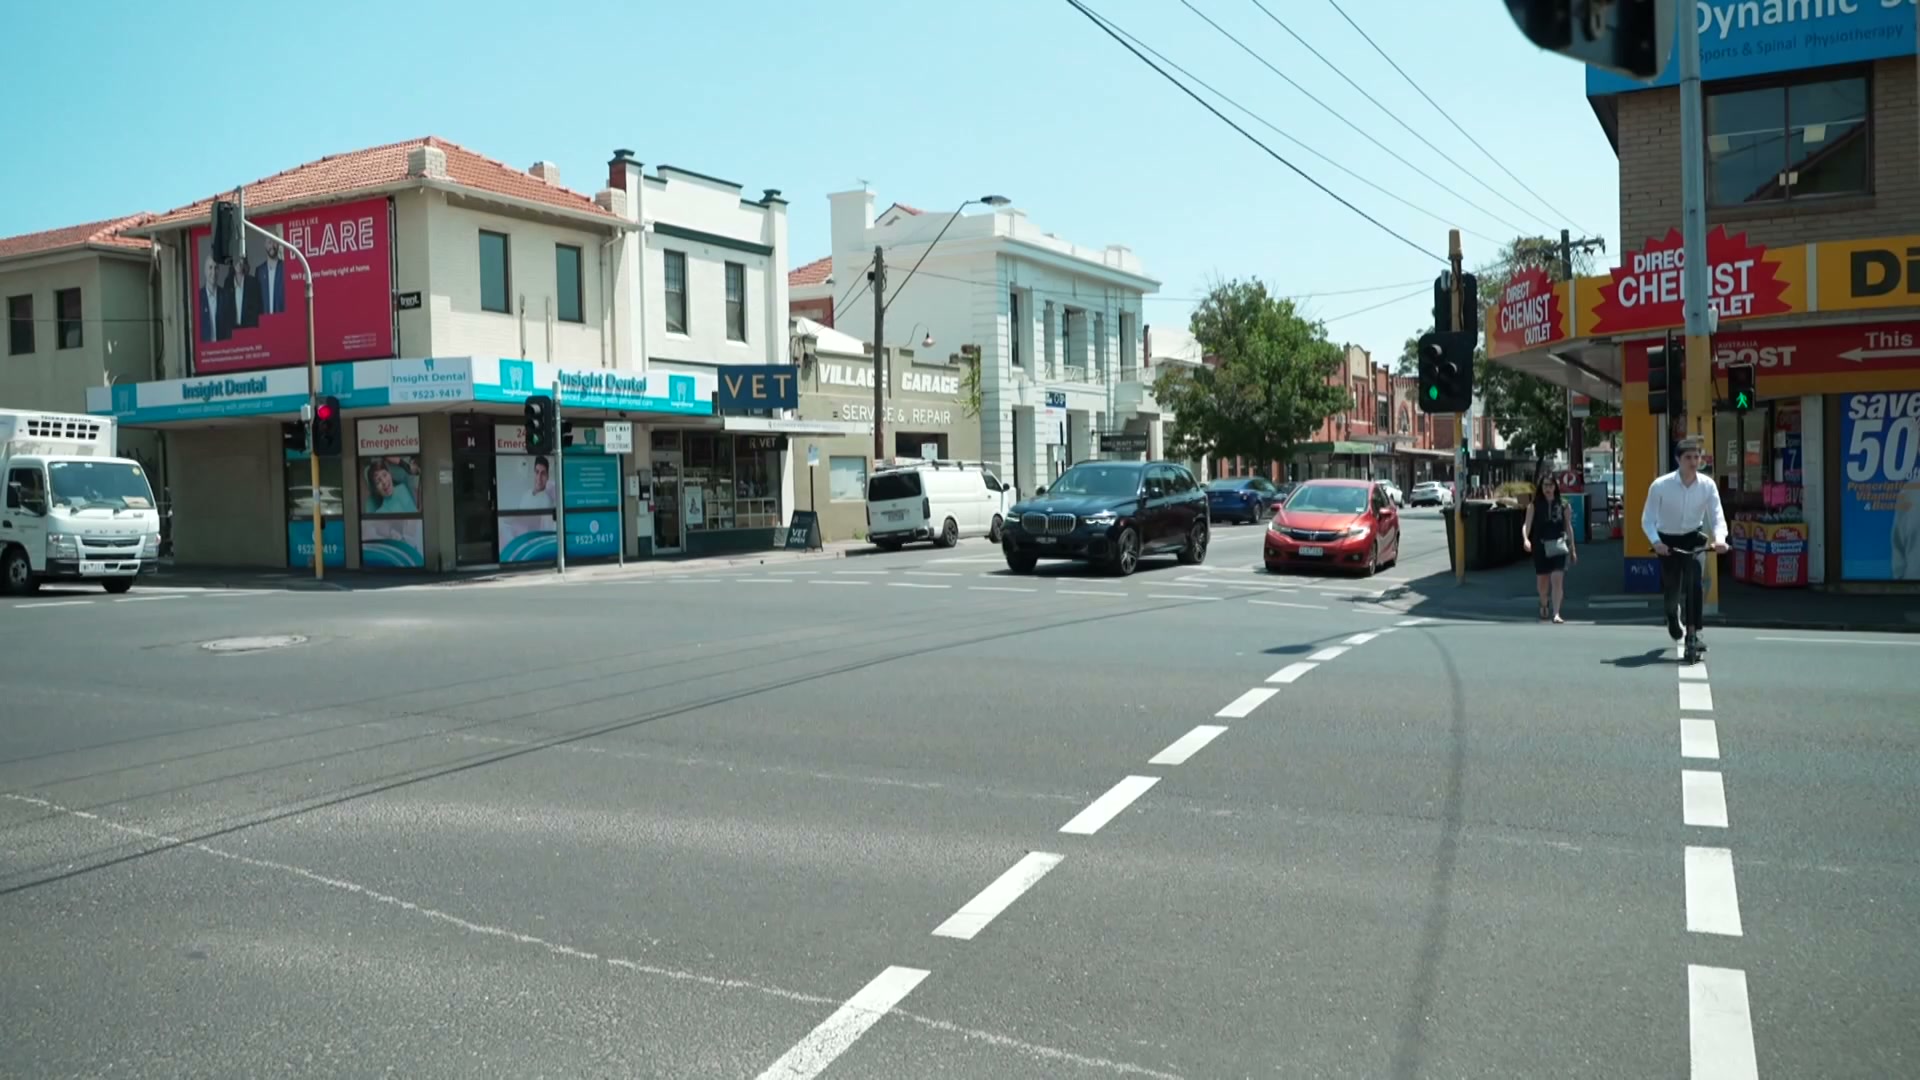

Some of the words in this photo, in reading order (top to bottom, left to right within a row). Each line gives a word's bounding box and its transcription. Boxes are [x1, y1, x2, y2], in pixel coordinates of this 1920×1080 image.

[1699, 47, 1738, 64] Sports
[1742, 41, 1752, 56] &
[1756, 35, 1797, 55] Spinal
[1805, 24, 1904, 48] Physiotherapy
[307, 217, 319, 226] LIKE
[289, 217, 374, 260] FLARE
[1634, 247, 1685, 274] DIREC
[1506, 281, 1530, 305] DIRECT
[1618, 259, 1754, 308] CHEIST
[1501, 293, 1551, 333] CHEMIST
[1524, 322, 1551, 345] OUTLET
[1718, 340, 1758, 349] AUSTRALIA
[1865, 330, 1913, 348] This
[1718, 345, 1797, 369] POST
[182, 381, 224, 402] Insight
[225, 376, 267, 396] Dental
[392, 374, 428, 384] Insight
[431, 373, 466, 382] Dental
[558, 369, 603, 391] Insight
[605, 373, 647, 392] Dental
[724, 374, 792, 399] VET
[902, 371, 960, 394] GARAGE
[412, 389, 461, 399] 9523-9419
[1848, 390, 1920, 420] save
[897, 408, 904, 422] &
[912, 409, 951, 424] REPAIR
[378, 424, 399, 435] 24hr
[360, 435, 419, 450] Emergencies
[759, 437, 776, 448] VET
[575, 533, 614, 545] 9523-9419
[792, 528, 808, 537] VET
